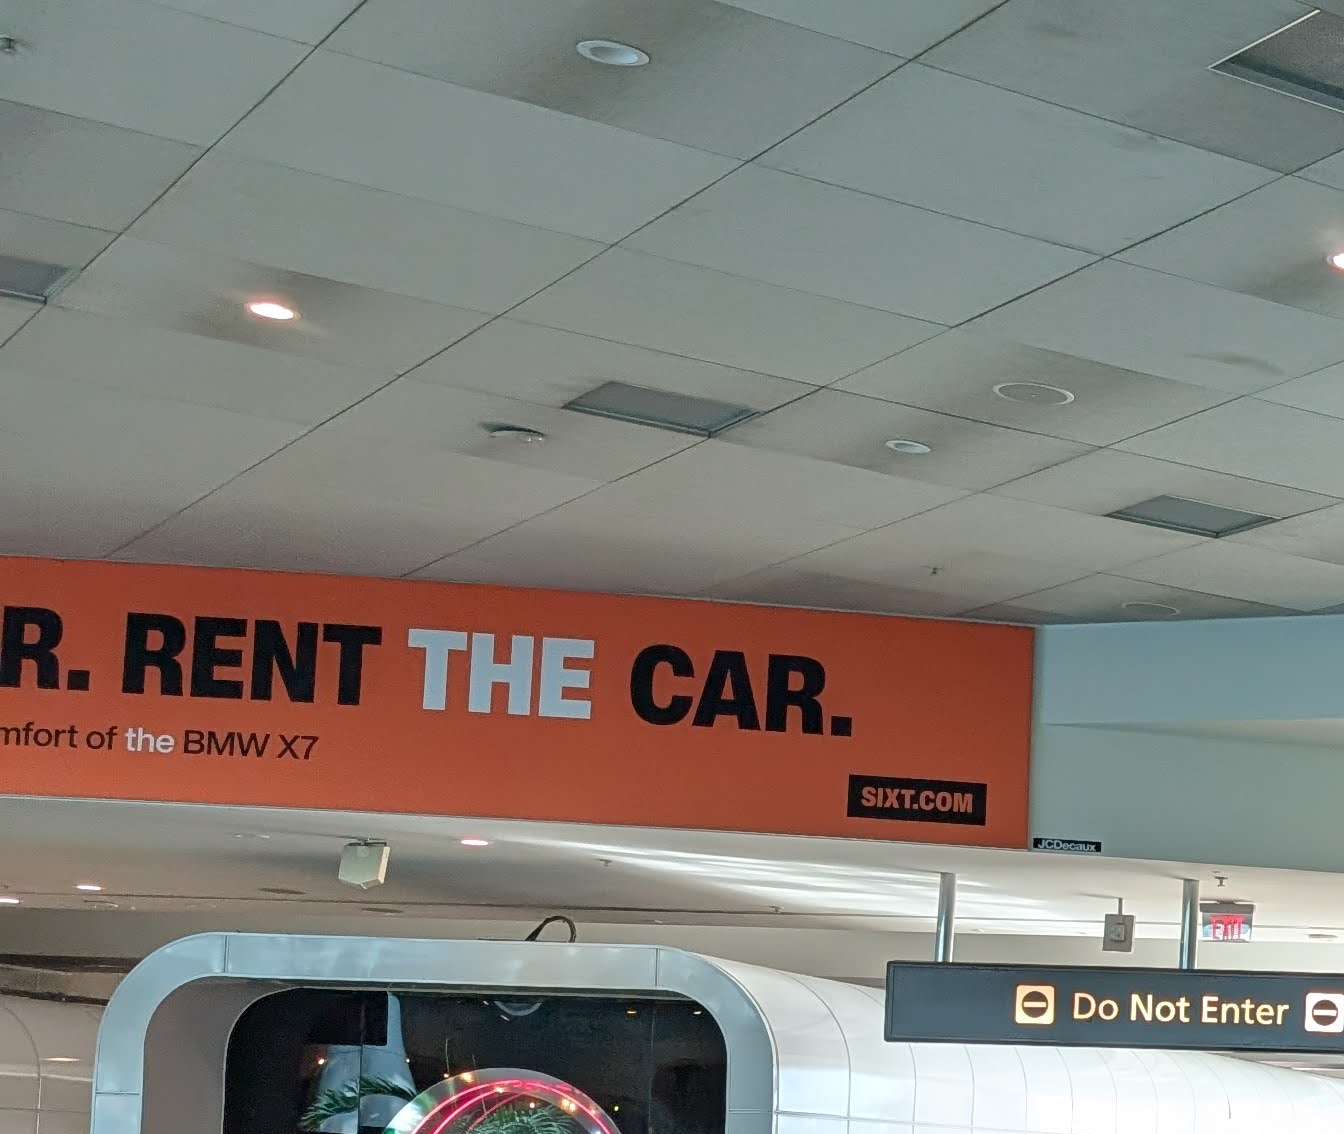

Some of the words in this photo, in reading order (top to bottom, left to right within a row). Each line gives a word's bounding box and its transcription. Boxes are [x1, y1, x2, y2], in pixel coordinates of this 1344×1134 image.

[0, 606, 90, 691] R.
[122, 611, 382, 706] RENT
[408, 628, 595, 720] THE
[630, 644, 852, 737] CAR.
[86, 726, 118, 751] of
[125, 726, 175, 753] the
[183, 729, 270, 758] BMW
[277, 734, 319, 760] X7
[861, 786, 973, 814] SIXT.COM
[1037, 839, 1097, 852] JCDecaux
[1072, 992, 1118, 1021] Do
[1130, 994, 1190, 1023] Not
[1201, 995, 1289, 1025] Enter
